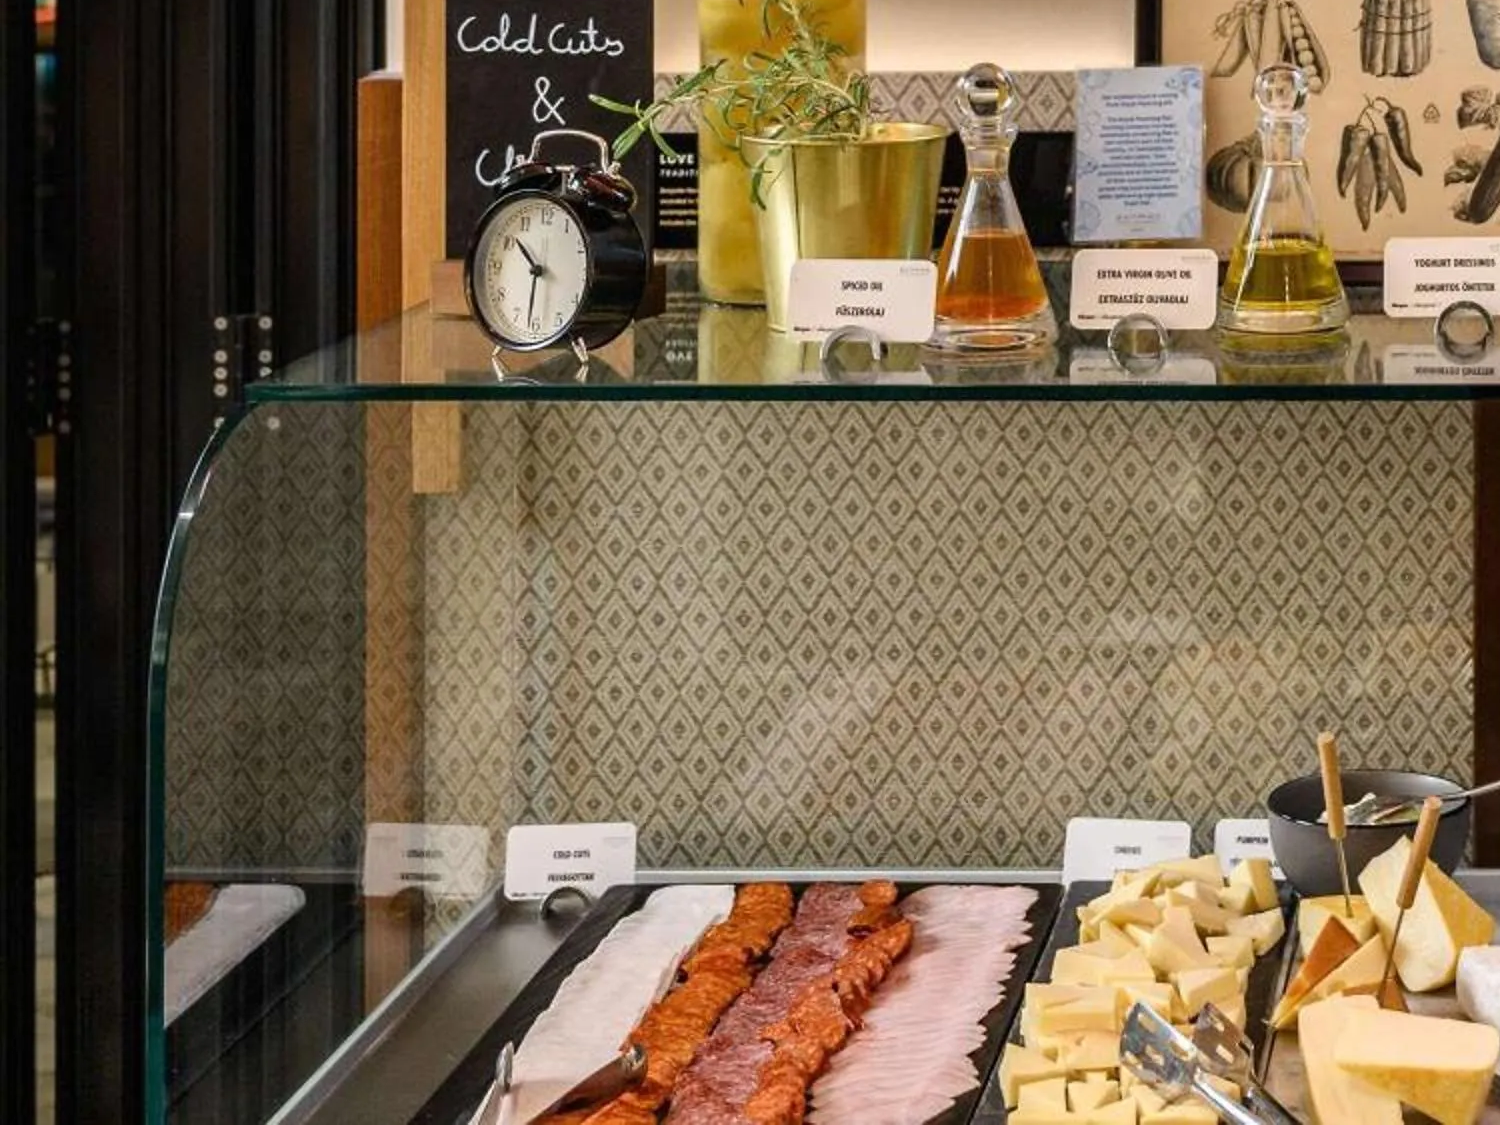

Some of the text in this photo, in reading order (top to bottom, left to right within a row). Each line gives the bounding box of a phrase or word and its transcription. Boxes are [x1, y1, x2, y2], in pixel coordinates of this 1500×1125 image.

[457, 12, 625, 57] Cold Cuts
[532, 76, 567, 126] &
[519, 216, 531, 232] 11
[541, 208, 555, 226] 12
[564, 218, 570, 234] 1
[1414, 258, 1451, 268] YOGHURT
[1097, 269, 1122, 279] EXTRA
[1124, 269, 1153, 279] VIRGIN
